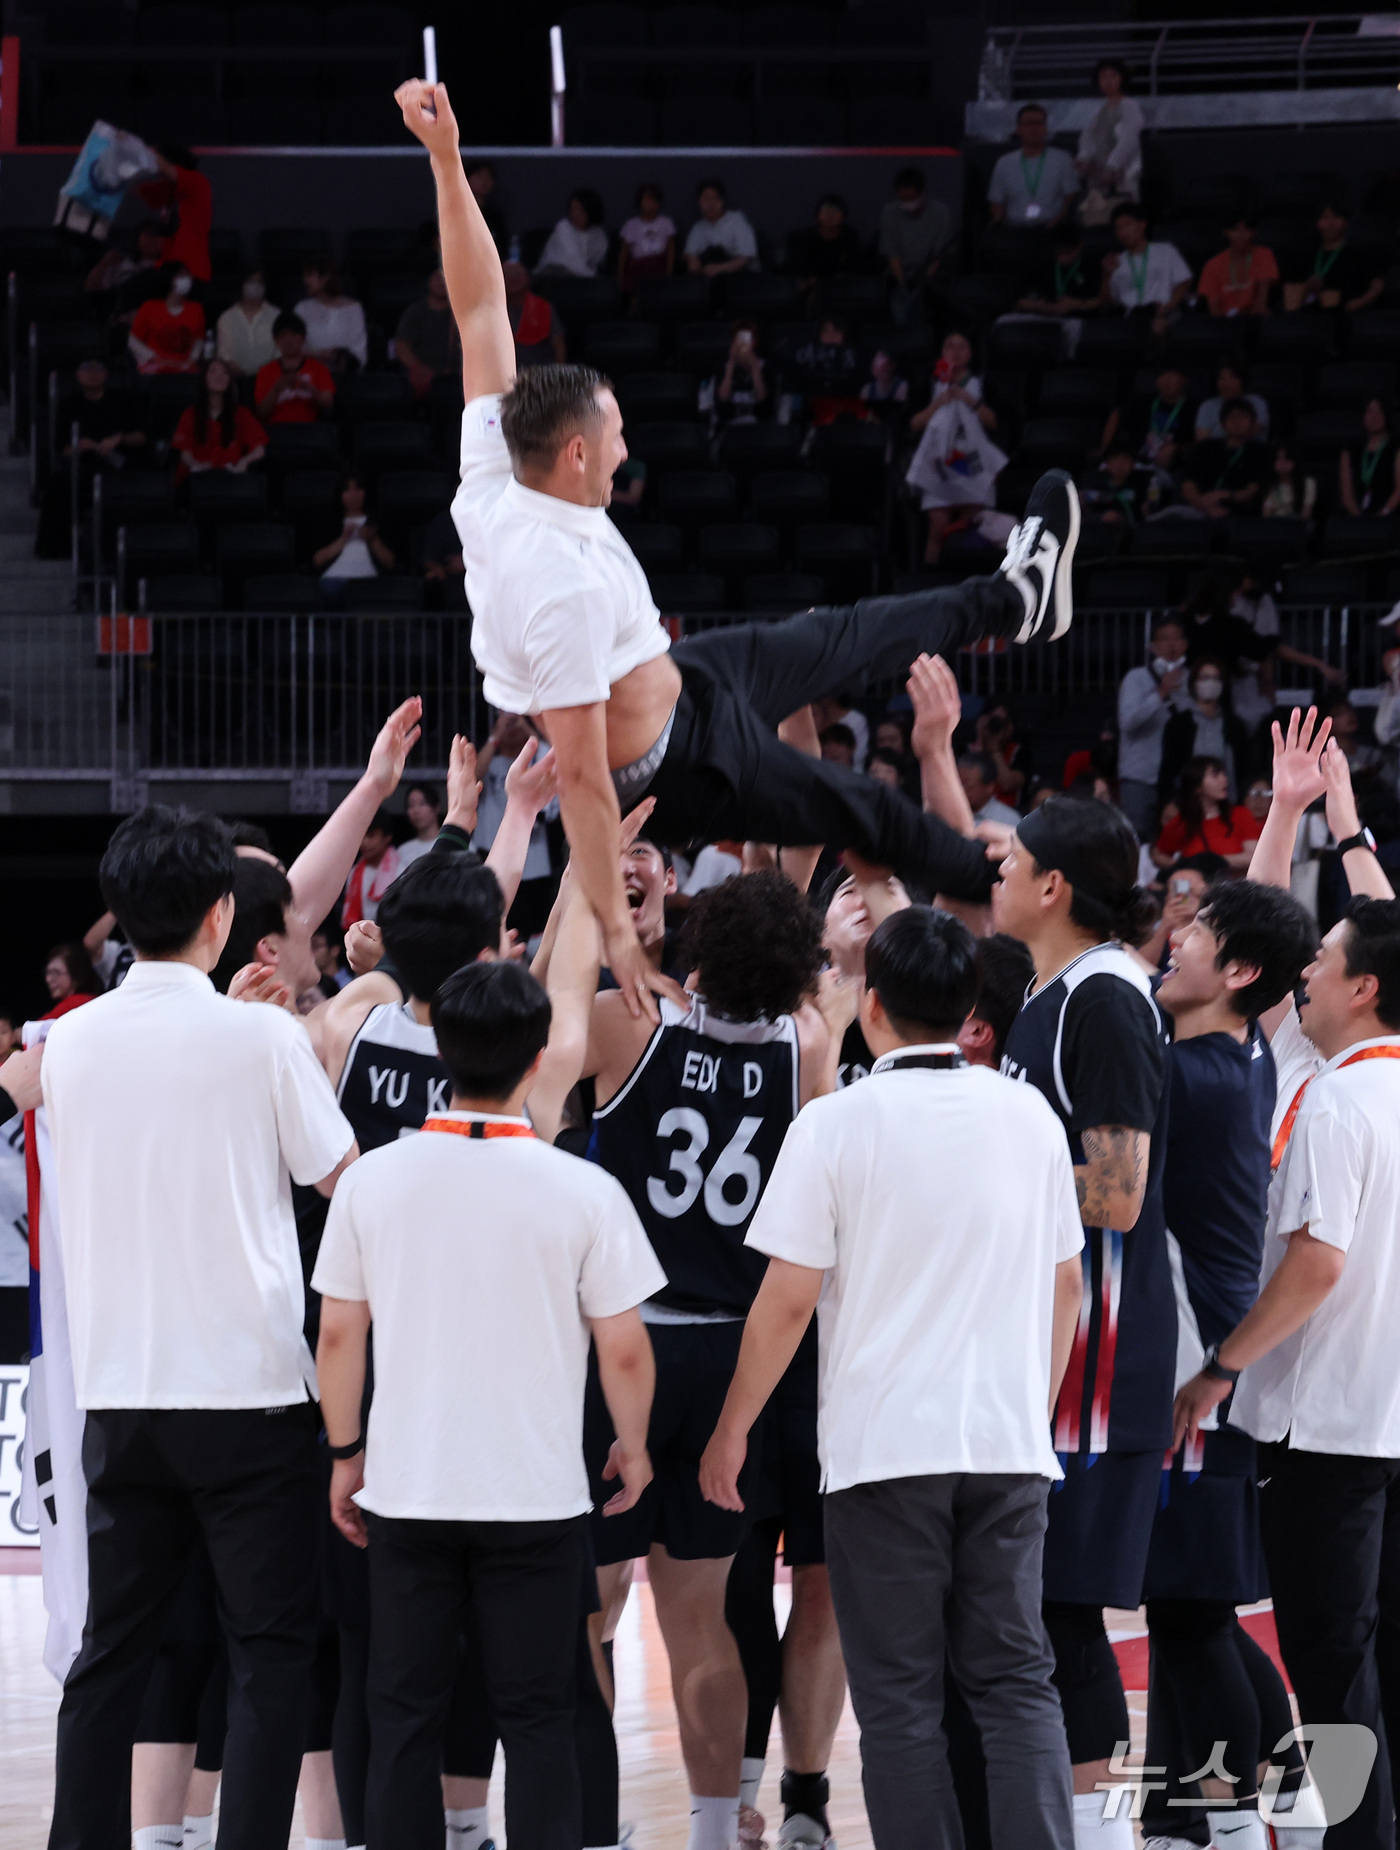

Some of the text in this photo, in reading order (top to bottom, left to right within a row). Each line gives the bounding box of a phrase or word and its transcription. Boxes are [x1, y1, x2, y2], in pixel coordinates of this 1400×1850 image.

[368, 1064, 449, 1113] YU K
[681, 1050, 763, 1098] EDI D
[647, 1107, 765, 1227] 36
